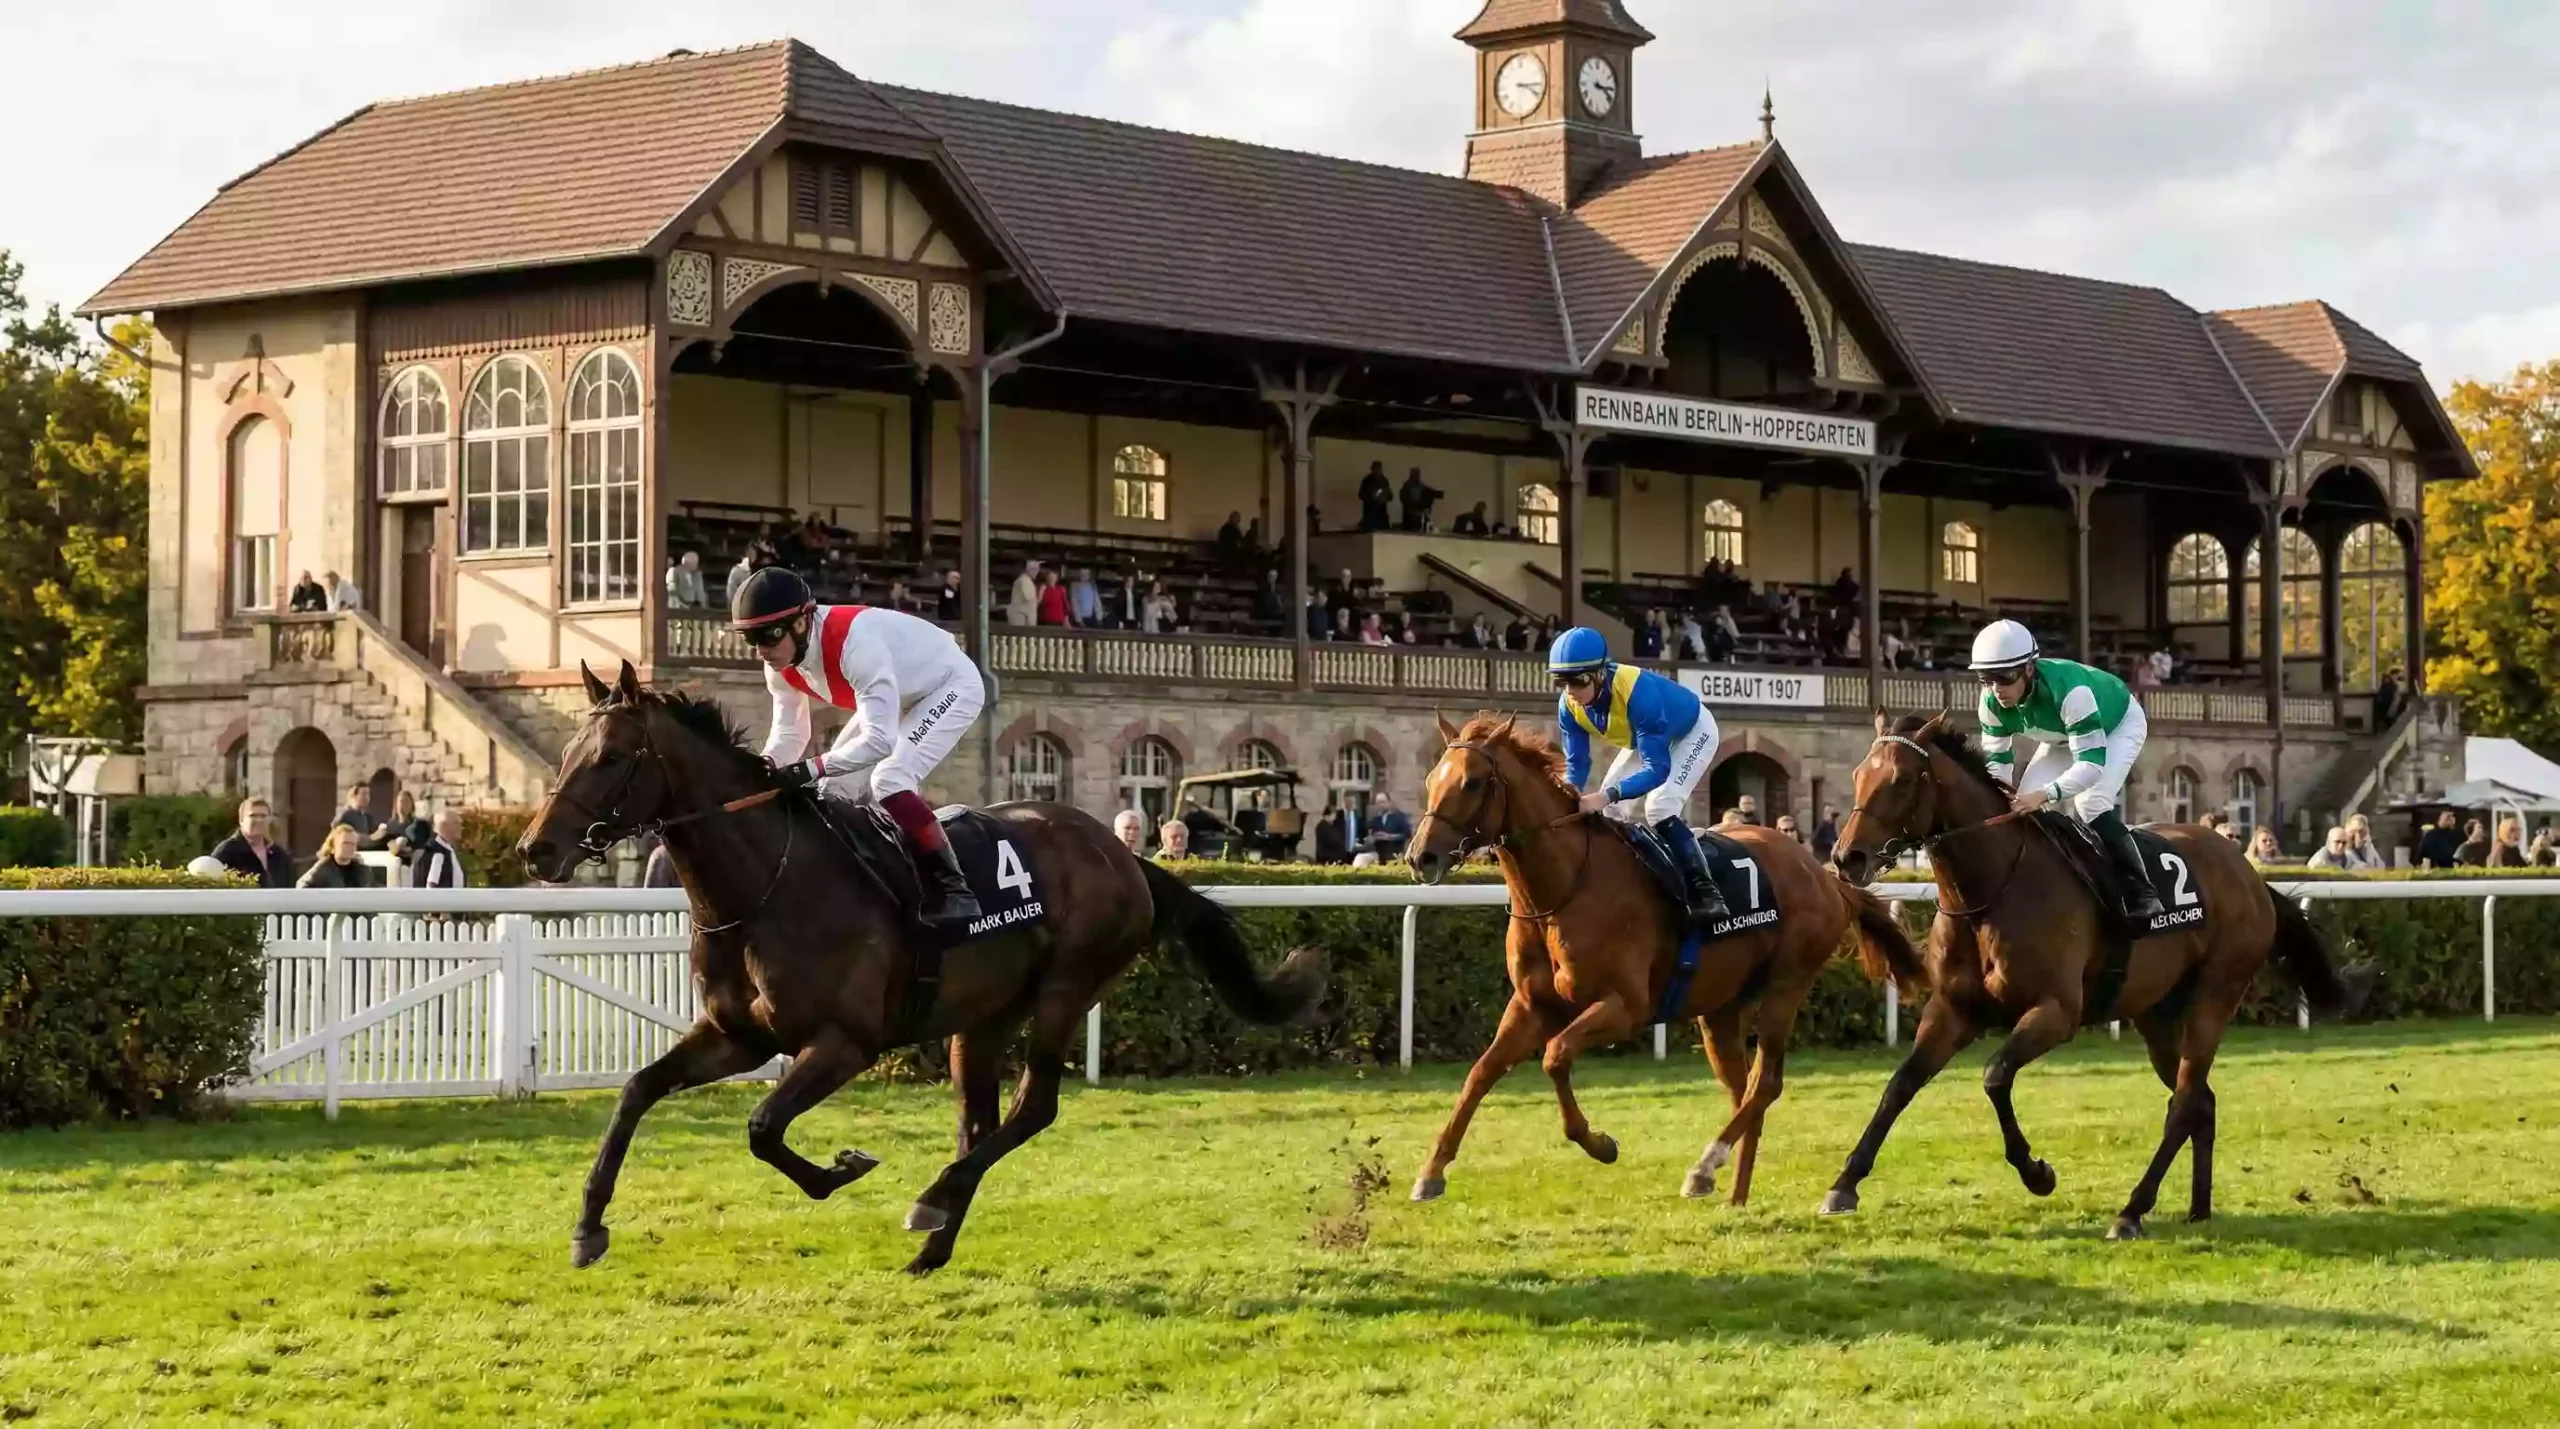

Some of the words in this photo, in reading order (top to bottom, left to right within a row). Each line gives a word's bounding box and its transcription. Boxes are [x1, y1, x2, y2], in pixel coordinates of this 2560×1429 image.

[1586, 396, 1678, 427] RENNBAHN
[1685, 408, 1866, 447] BERLIN-HOPPEGARTEN
[1701, 675, 1763, 699] GEBAUT
[1768, 679, 1802, 700] 1907
[997, 839, 1033, 900] 4
[1730, 857, 1760, 909] 7
[2159, 853, 2198, 906] 2
[969, 912, 1003, 935] MARK
[1003, 902, 1043, 924] BAUER
